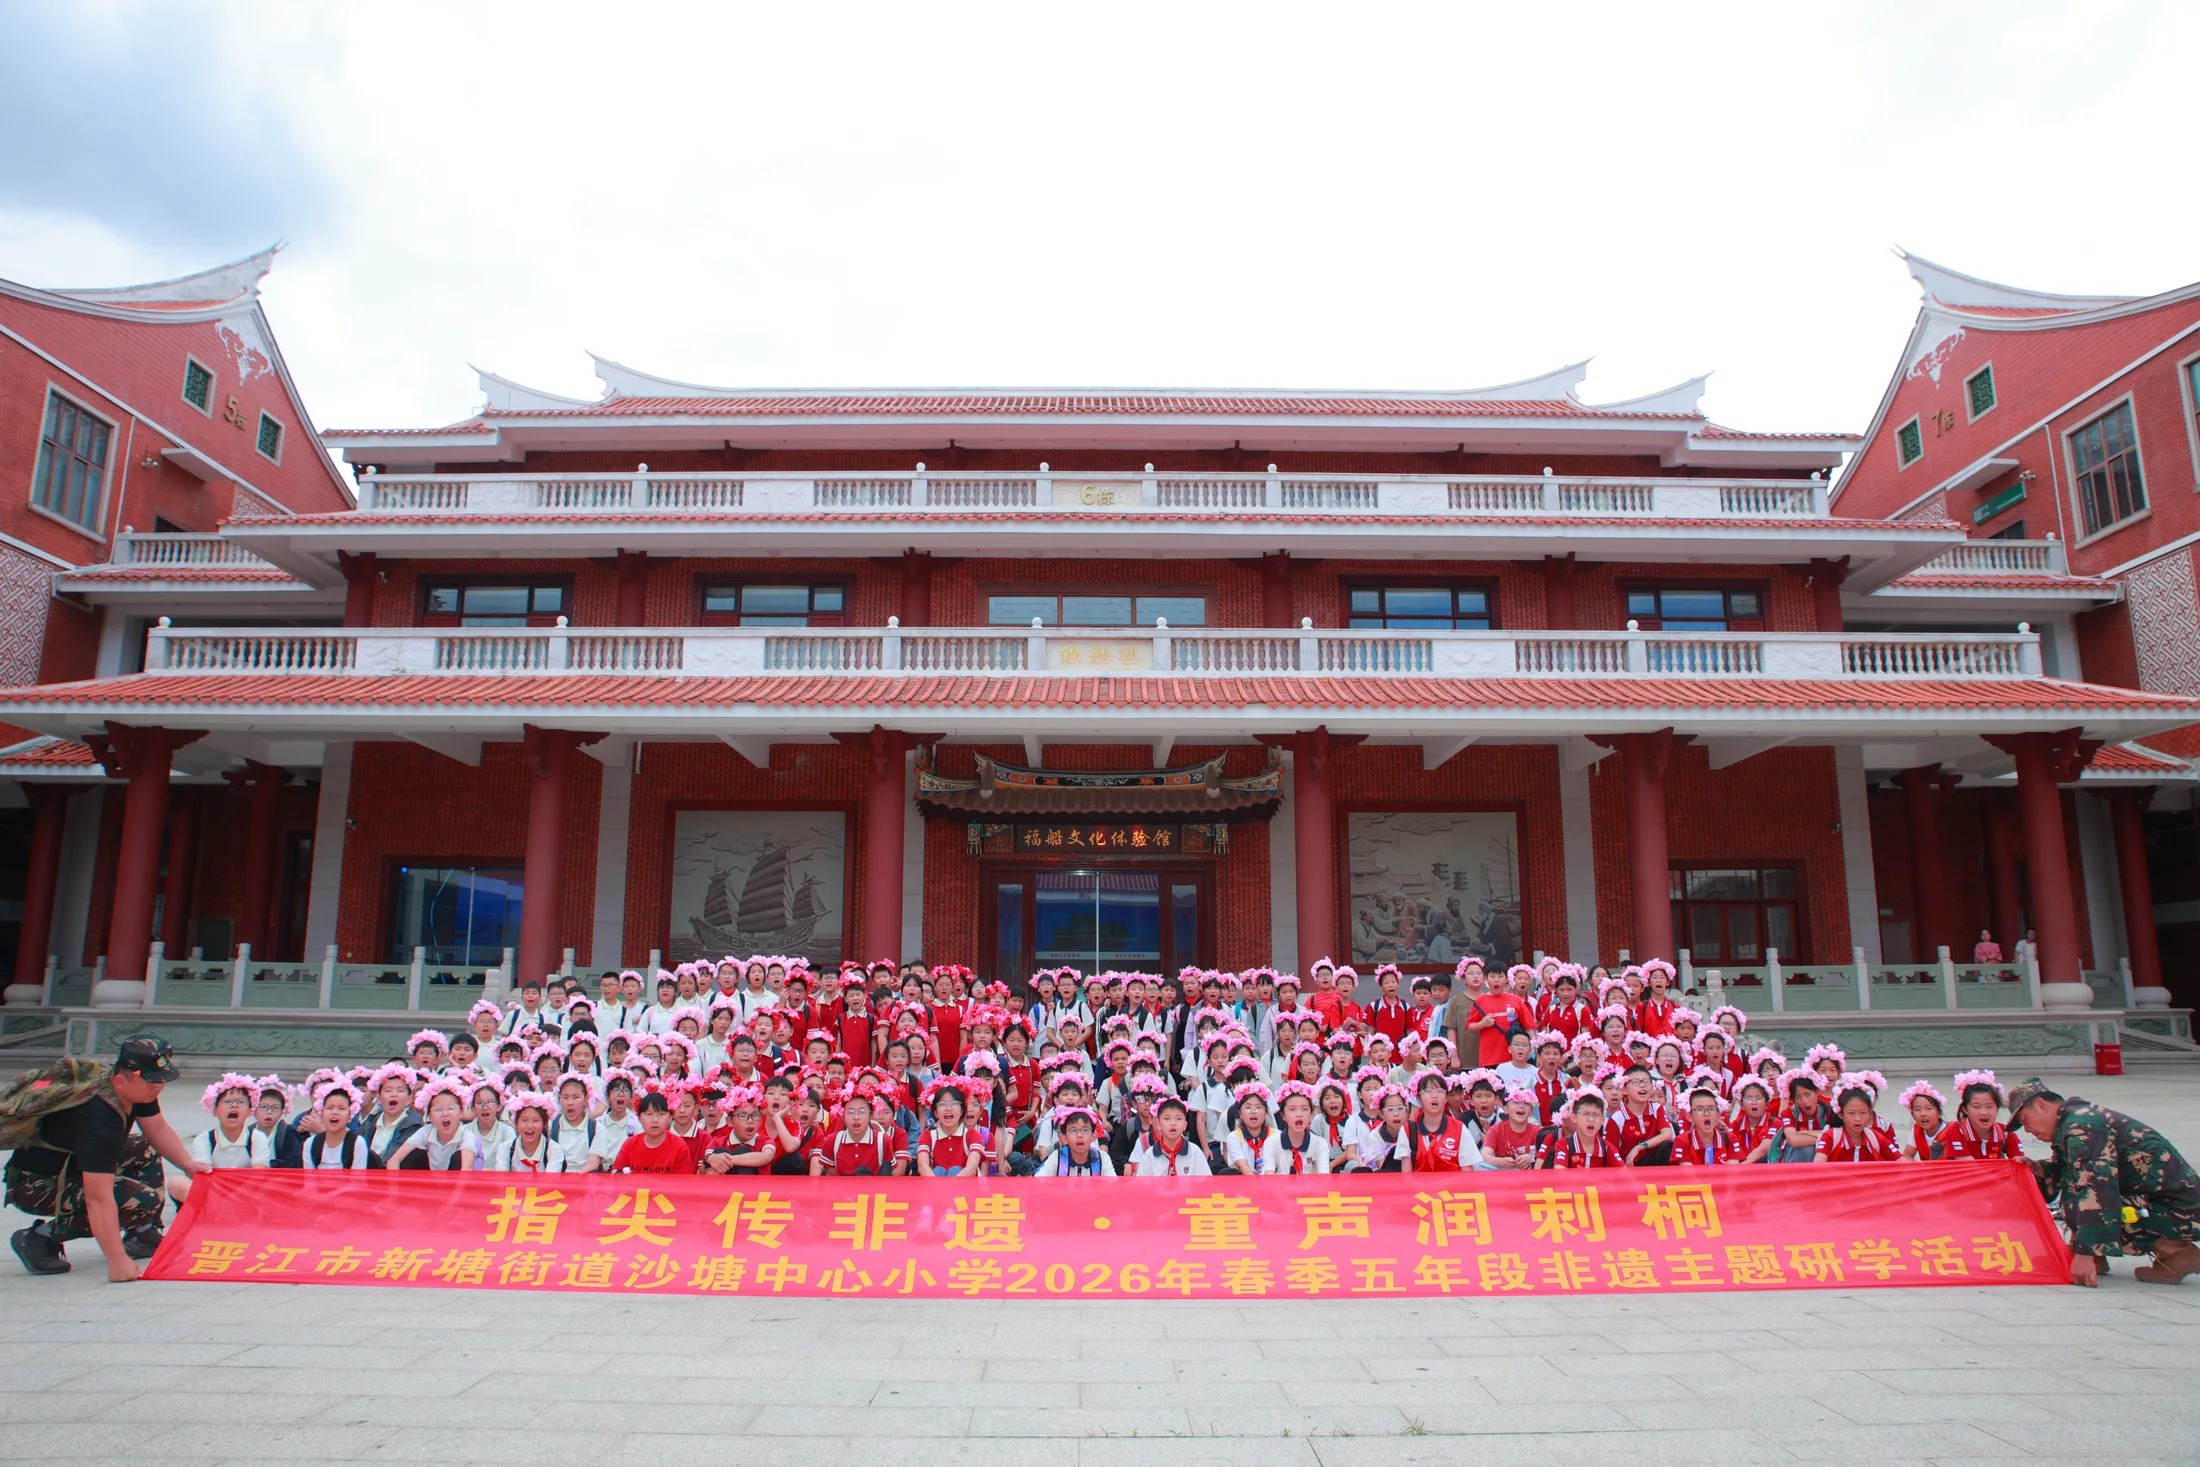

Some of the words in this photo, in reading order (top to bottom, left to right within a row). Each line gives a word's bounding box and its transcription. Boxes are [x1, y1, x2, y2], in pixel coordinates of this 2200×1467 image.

[188, 1232, 2033, 1296] 晋江市新塘街道沙塘中心小学2026年春季五年段非遗主题研学活动
